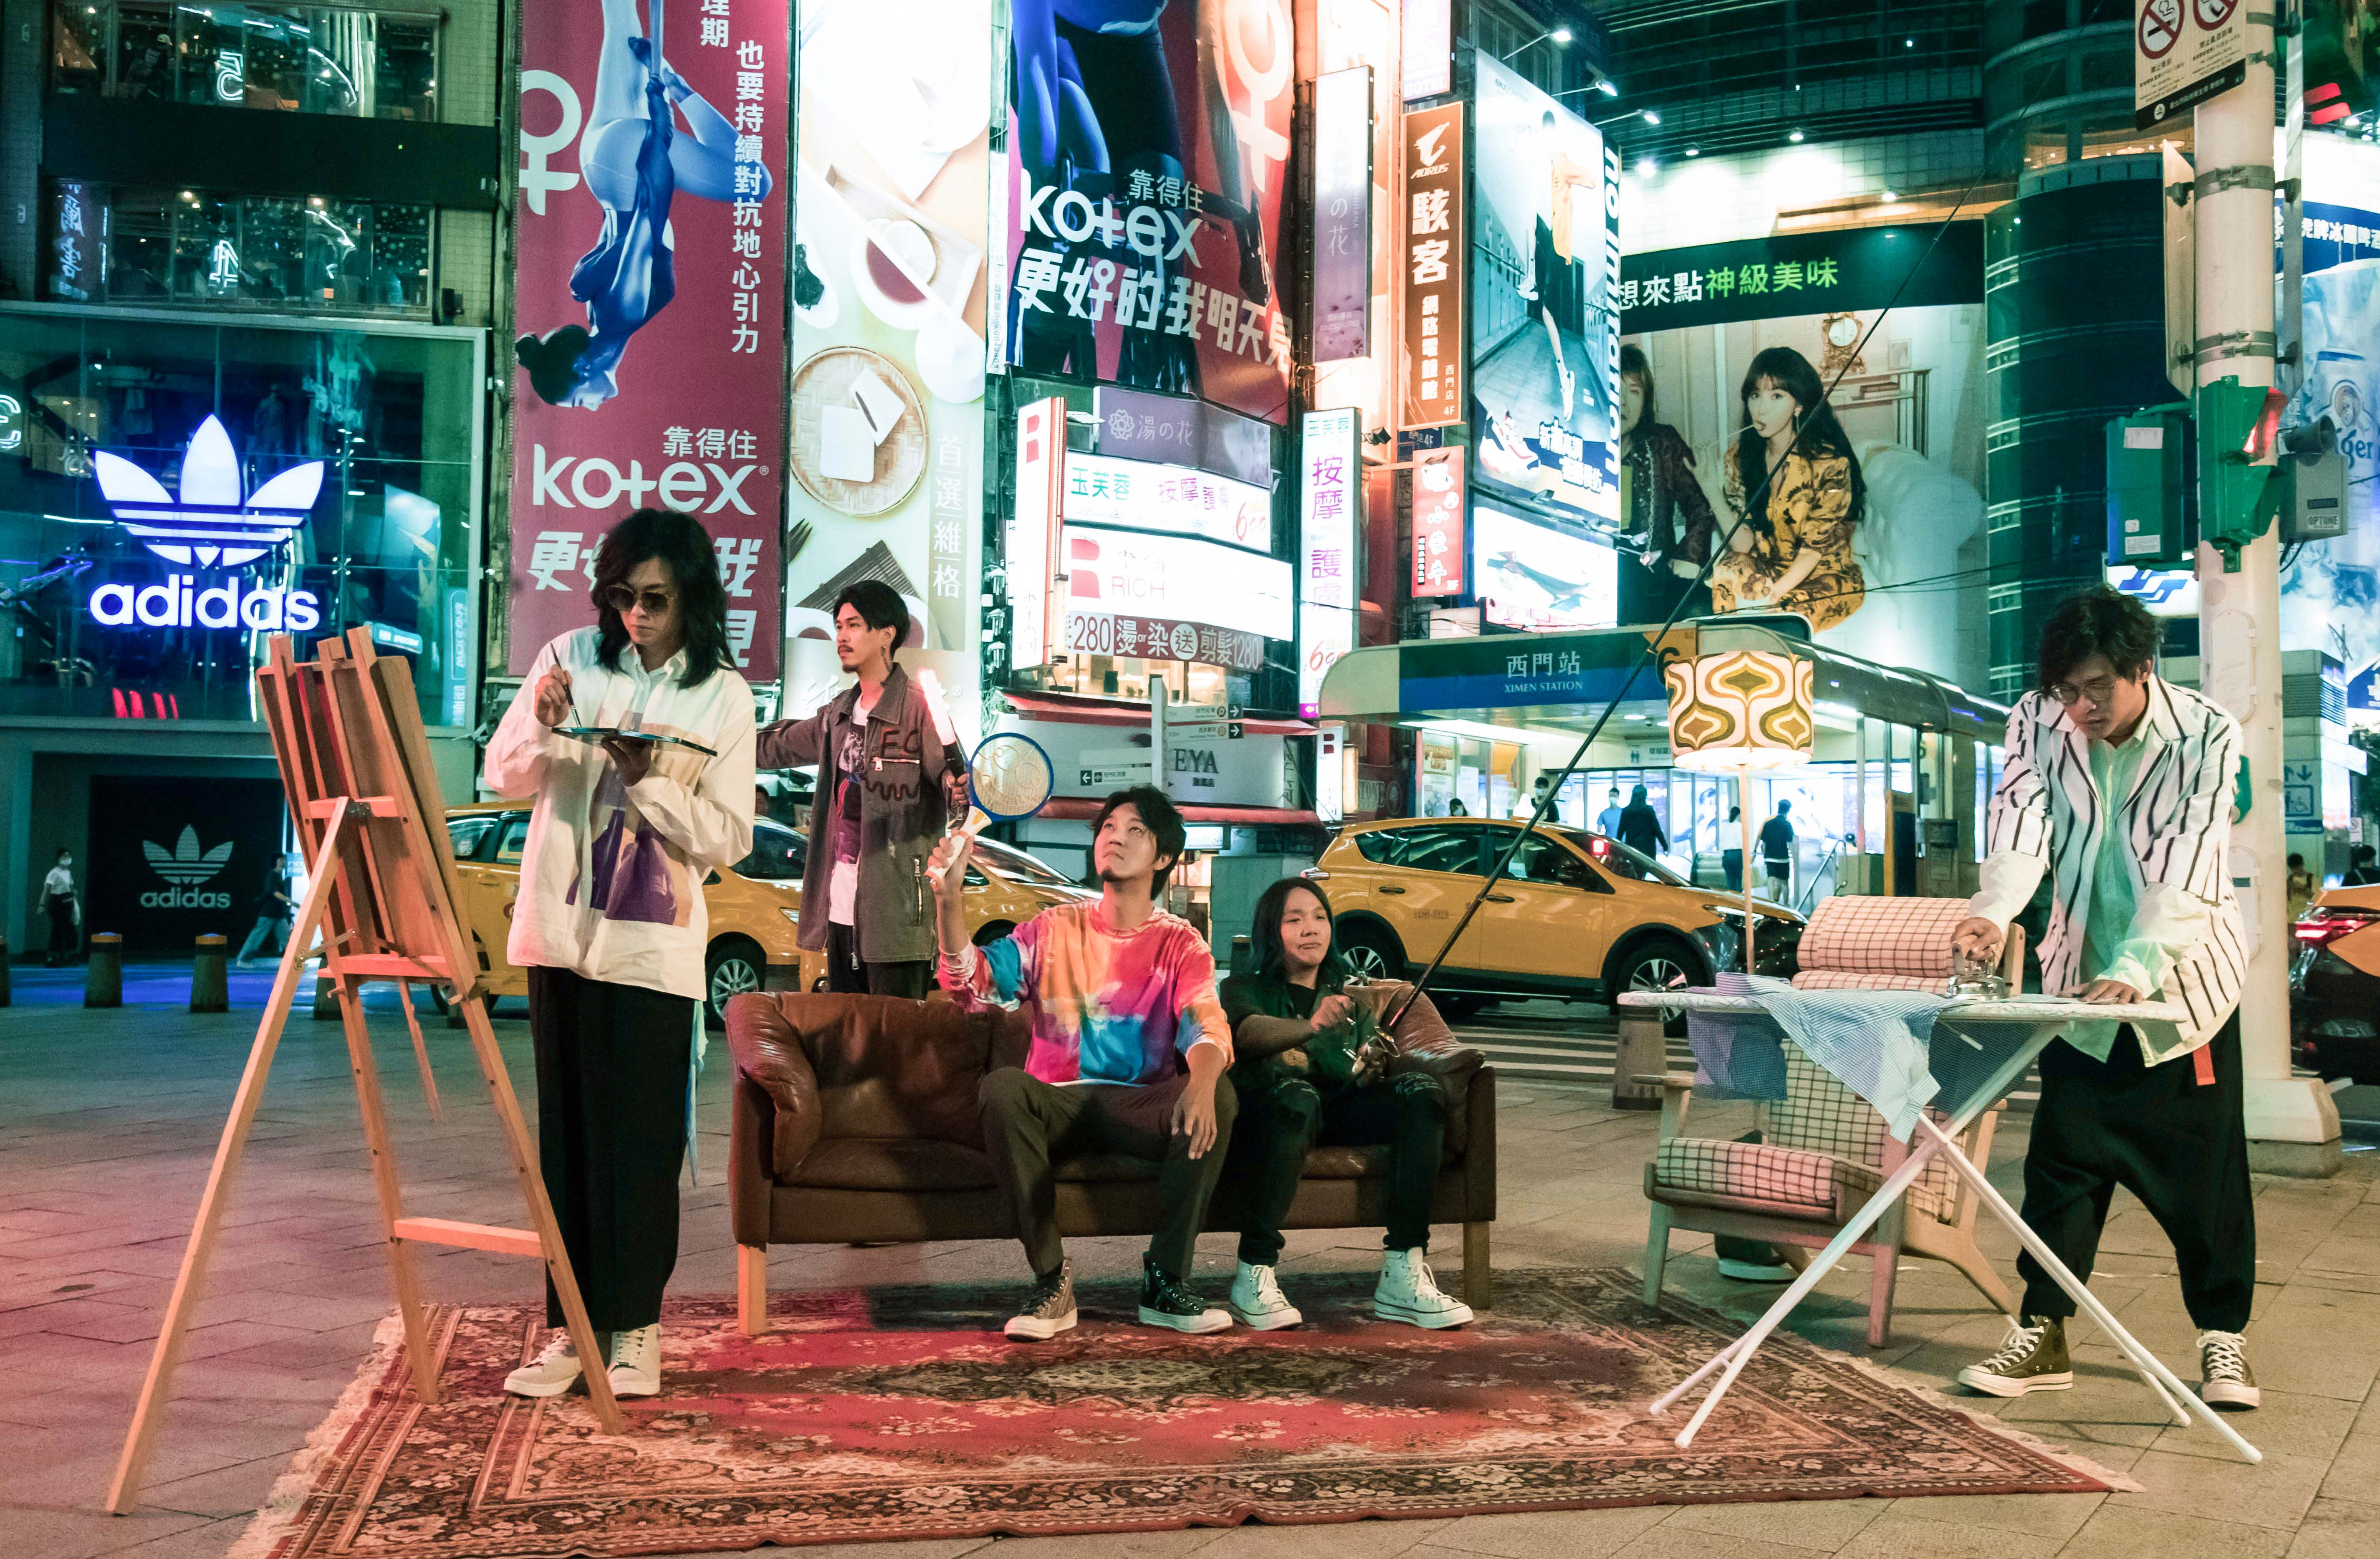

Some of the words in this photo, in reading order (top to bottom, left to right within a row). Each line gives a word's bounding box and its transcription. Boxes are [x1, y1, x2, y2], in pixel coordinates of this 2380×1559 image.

[1410, 163, 1450, 179] AORUS
[1605, 147, 1620, 219] no
[732, 40, 765, 354] 也要持續對抗地心引力
[1129, 169, 1203, 214] 靠得住
[1020, 168, 1202, 268] kotex
[1412, 188, 1450, 285] 駭客
[1619, 257, 1839, 311] 想來點神級美味
[1014, 247, 1293, 374] 更好的我明天見
[1445, 364, 1455, 400] 西門店
[1308, 417, 1349, 436] 玉芙蓉
[1443, 405, 1455, 416] 4F
[663, 426, 758, 459] 靠得住
[1137, 414, 1193, 447] 湯の花
[533, 444, 758, 515] kotex
[1071, 467, 1130, 500] 玉芙蓉
[1312, 455, 1343, 520] 按摩
[932, 435, 964, 599] 首選維格
[89, 574, 320, 630] adidas
[1112, 576, 1165, 599] RICH
[1175, 629, 1195, 654] 送
[1506, 651, 1581, 678] 西門站
[1504, 683, 1536, 693] XIMEN
[1540, 680, 1583, 691] STATION
[141, 887, 231, 908] adidas
